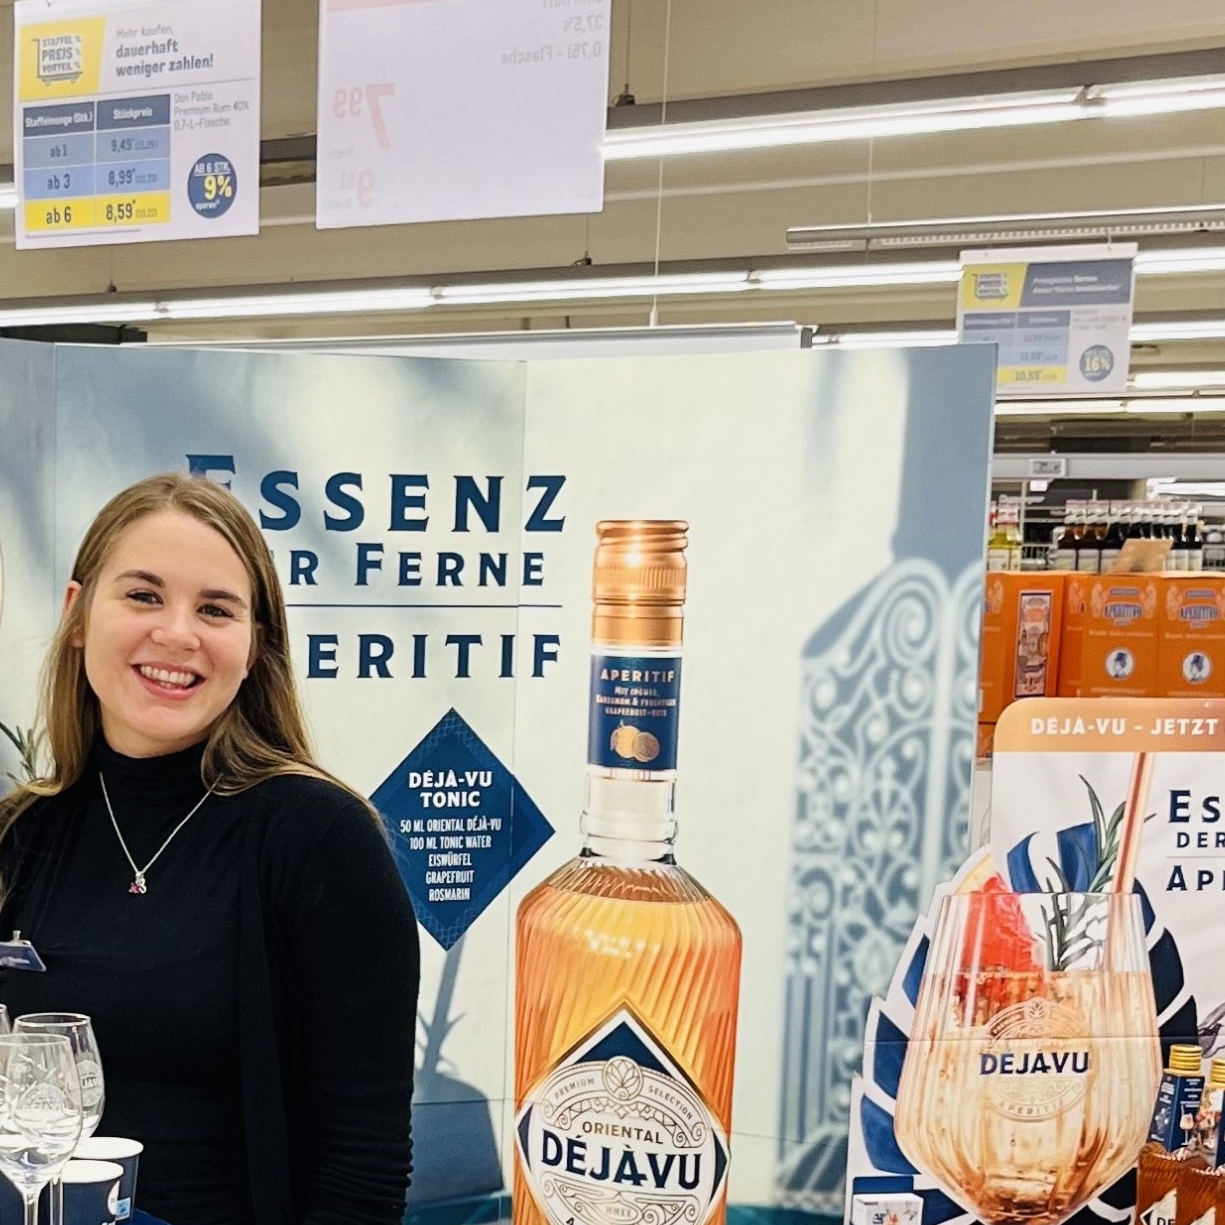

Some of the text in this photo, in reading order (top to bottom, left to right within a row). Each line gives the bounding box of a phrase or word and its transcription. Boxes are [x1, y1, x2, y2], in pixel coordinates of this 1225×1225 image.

[116, 28, 139, 39] Mehr
[42, 47, 73, 62] PREIS
[116, 39, 178, 58] dauerhaft
[116, 53, 214, 78] weniger zahlen!
[191, 91, 213, 101] Pablo
[174, 104, 211, 116] Premium
[213, 103, 231, 113] Rum
[50, 145, 61, 157] ab
[194, 163, 205, 174] AB
[47, 173, 71, 190] ab 3
[204, 175, 232, 200] 9%
[46, 208, 72, 224] ab 6
[1083, 355, 1111, 374] 16%
[354, 542, 545, 587] FERNE
[306, 634, 561, 679] ERITIF
[600, 668, 675, 682] APERITIF
[1151, 718, 1218, 736] JETZT
[420, 791, 480, 808] TONIC
[400, 819, 411, 832] 50
[413, 818, 425, 831] ML
[426, 818, 465, 831] ORIENTAL
[410, 835, 492, 850] 100 ML TONIC WATER
[428, 852, 472, 867] EISWÜRFEL
[425, 870, 474, 884] GRAPEFRUIT
[1166, 864, 1225, 891] AP
[429, 888, 471, 901] ROSMARIN
[554, 1077, 693, 1121] PREMIUM SELECTION
[582, 1121, 664, 1145] ORIENTAL
